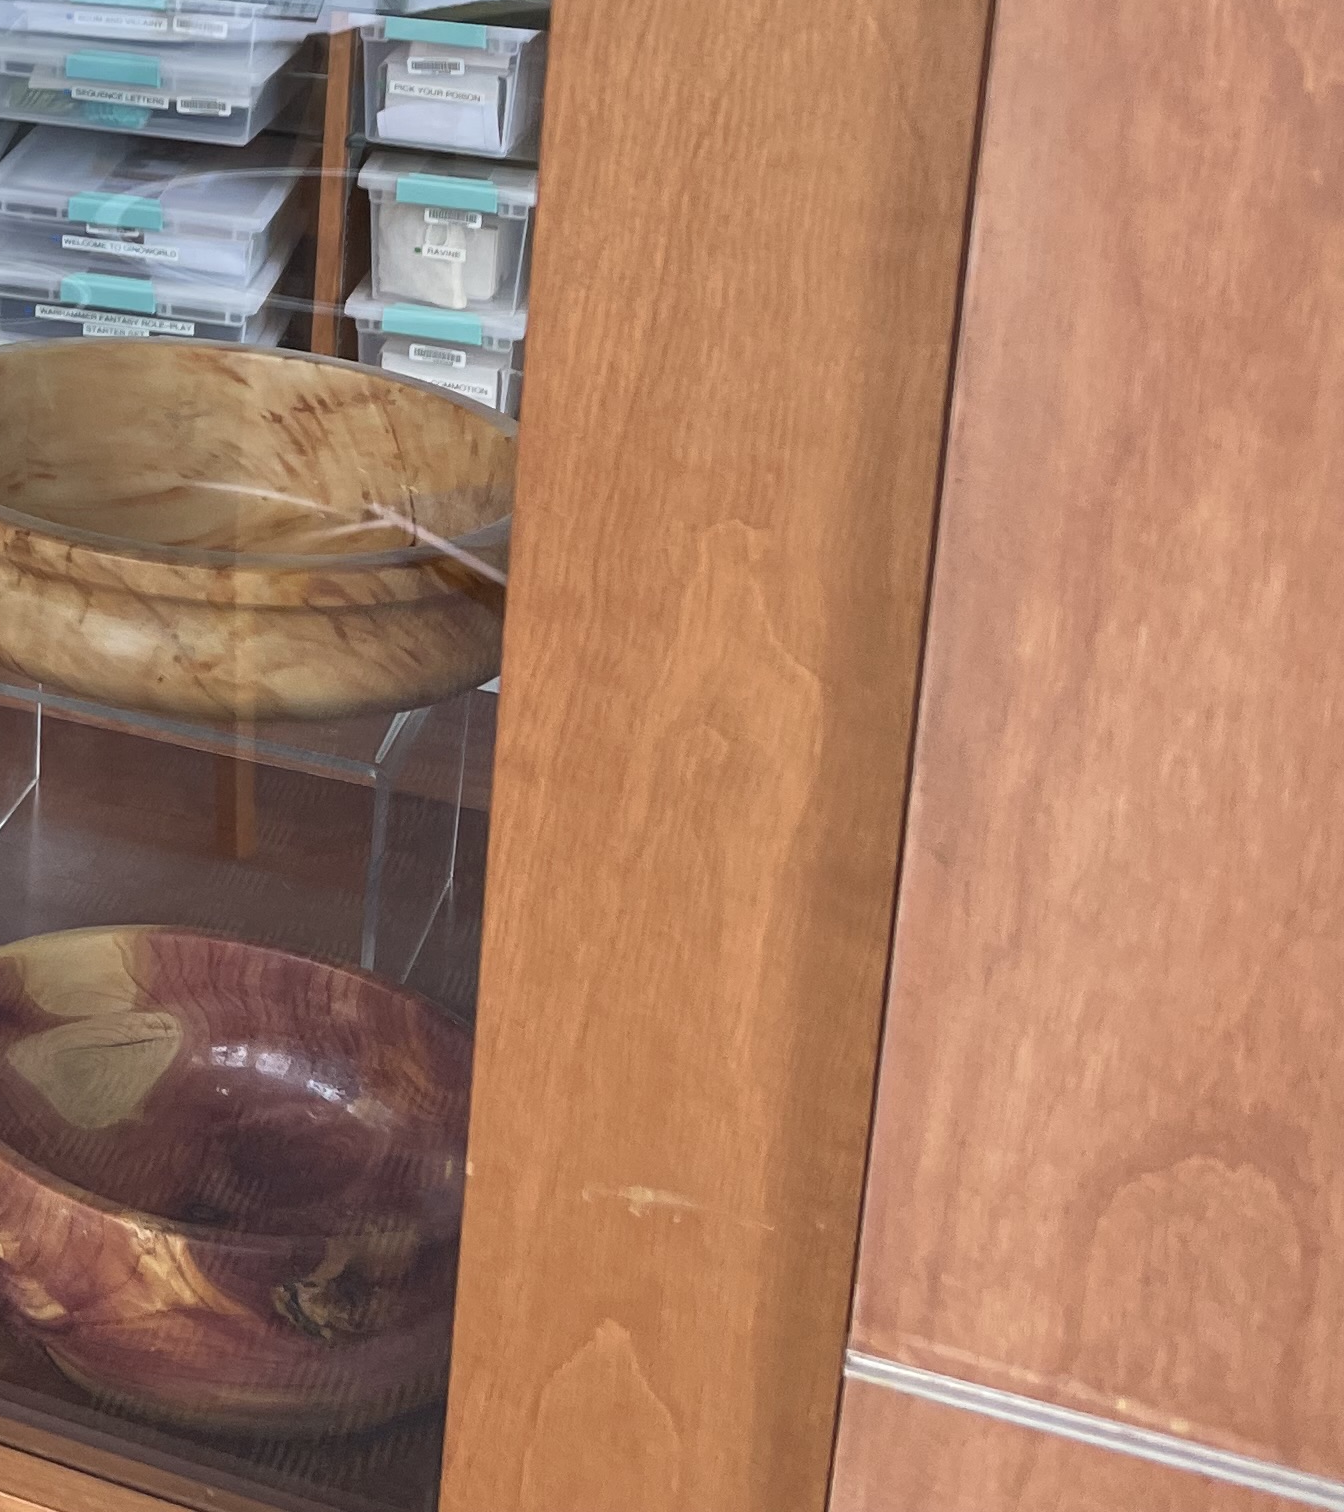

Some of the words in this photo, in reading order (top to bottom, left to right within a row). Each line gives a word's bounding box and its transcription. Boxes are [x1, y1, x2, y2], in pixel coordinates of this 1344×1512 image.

[75, 88, 123, 100] SEQUENCE
[125, 93, 166, 106] LETTERS
[394, 83, 415, 92] PICK
[417, 87, 443, 97] YOUR
[64, 238, 107, 249] WELCOME
[110, 243, 121, 252] TO
[427, 247, 461, 259] RAVINE
[39, 307, 97, 321] WARHAMMER
[98, 314, 141, 326] FANTASY
[85, 324, 125, 336] STARTER
